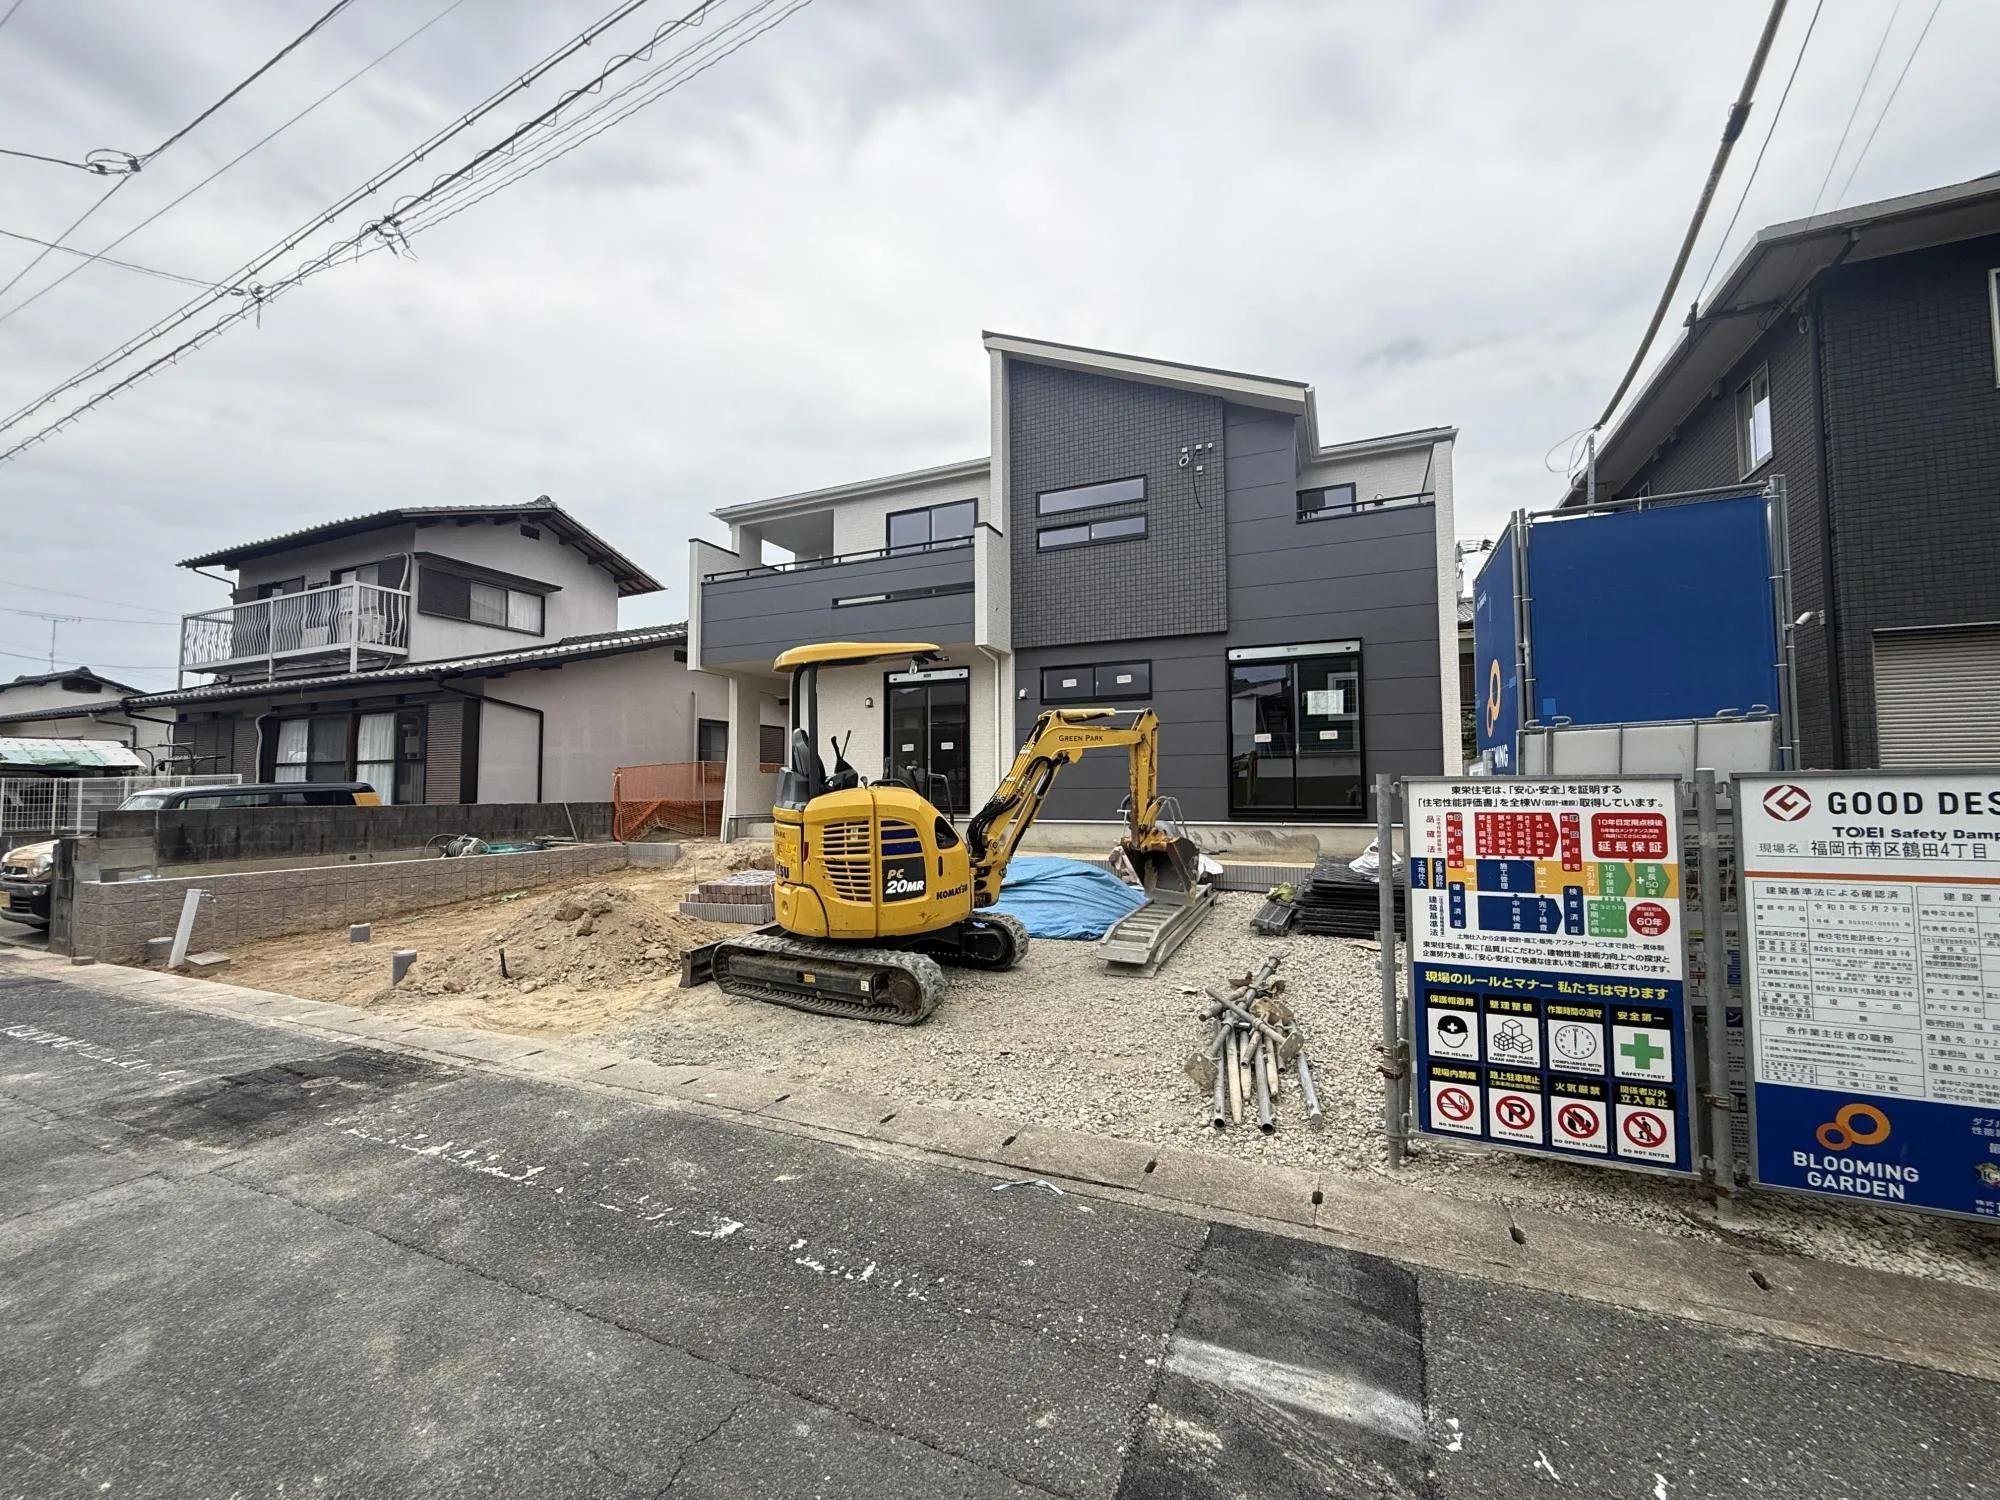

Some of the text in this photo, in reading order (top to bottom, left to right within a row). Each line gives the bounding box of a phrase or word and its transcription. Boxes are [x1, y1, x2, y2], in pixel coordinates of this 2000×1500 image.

[1058, 734, 1104, 742] GREEN PARK
[1828, 791, 2000, 815] GOOD DES
[1891, 828, 1947, 841] Safety
[1597, 840, 1663, 853] 延長保証
[1758, 840, 1987, 859] 現場名 福岡市南区鶴田4丁目
[888, 868, 904, 880] PC
[1417, 860, 1426, 887] 土地仕入
[885, 880, 925, 894] 20MR
[936, 884, 968, 900] KOMATSU
[1766, 886, 1899, 899] 建築基準法による確認済
[1636, 917, 1663, 927] 60年
[1425, 970, 1669, 1000] 現場のルールとマナー 私たちは守ります
[1617, 1011, 1665, 1022] 安全第一
[1786, 1026, 1894, 1044] 各作業主任者の職務
[1555, 1082, 1601, 1096] 火気厳禁
[1619, 1085, 1667, 1097] 関係者以外
[1620, 1096, 1668, 1107] 立入禁止
[1793, 1151, 1920, 1183] BLOOMING
[1807, 1171, 1905, 1200] GARDEN
